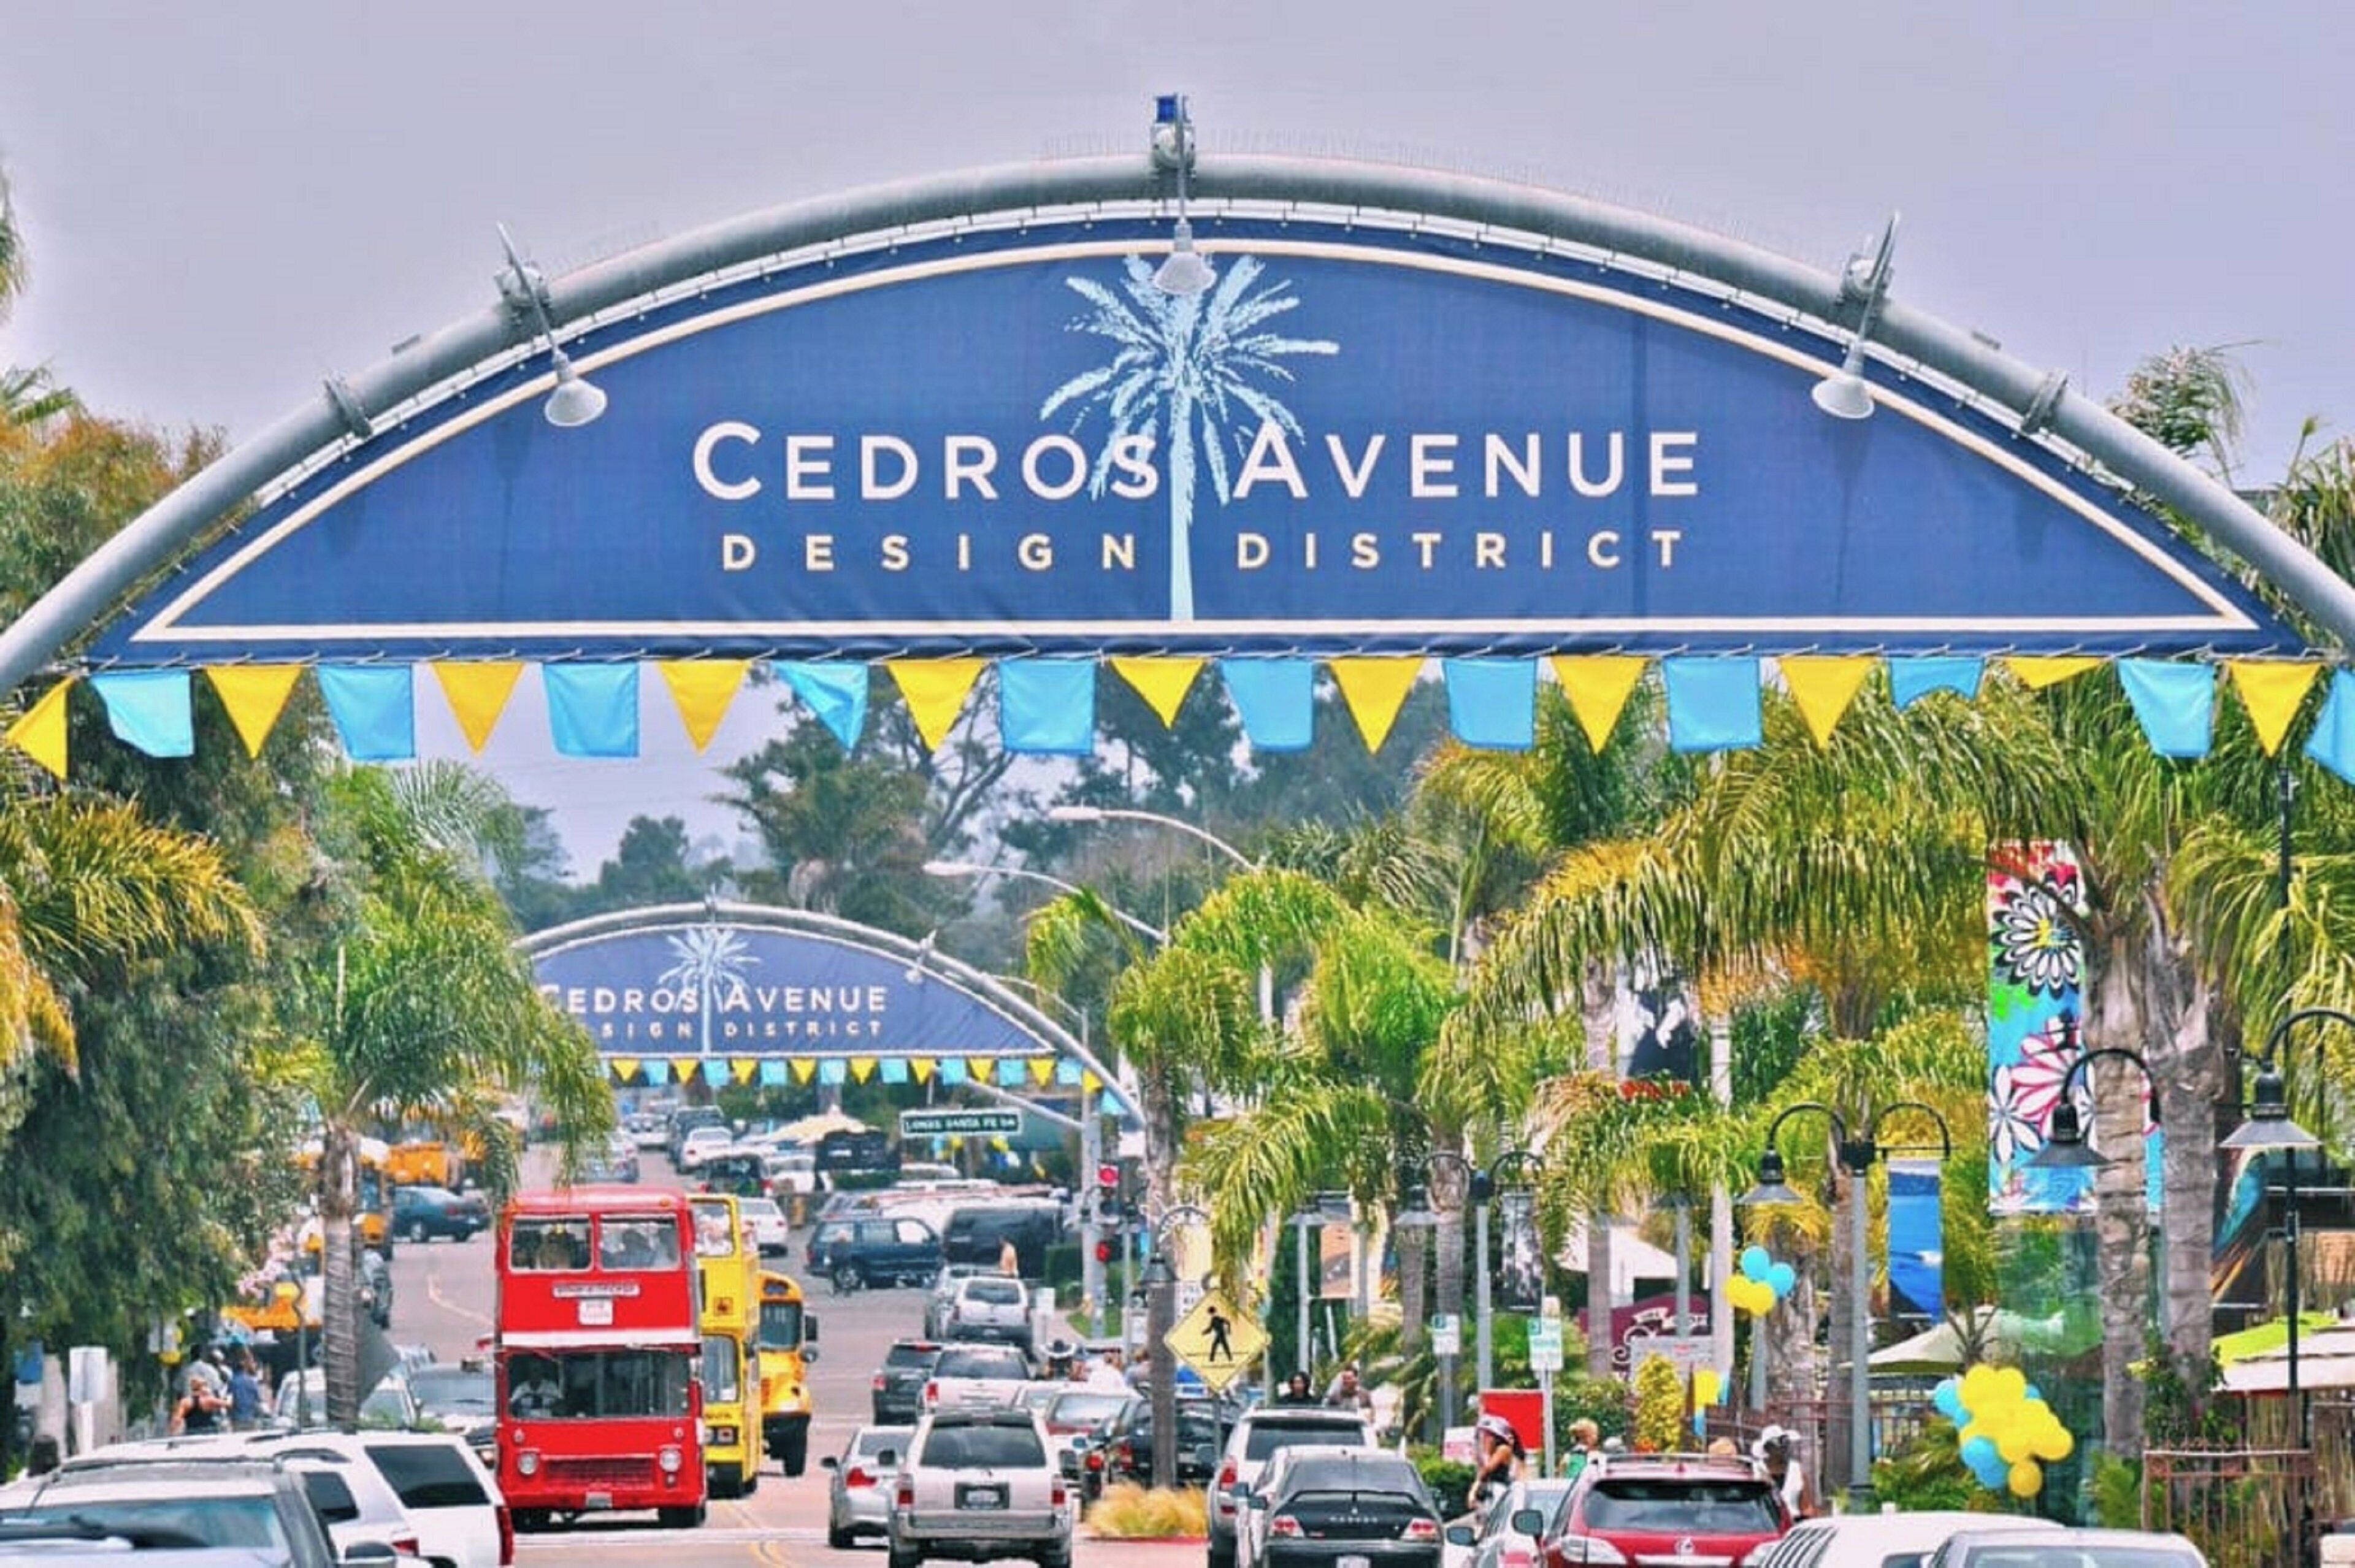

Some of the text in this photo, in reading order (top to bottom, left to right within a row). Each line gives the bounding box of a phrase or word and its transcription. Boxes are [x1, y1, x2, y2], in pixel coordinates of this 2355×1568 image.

[693, 420, 1698, 500] CEDROS AVENUE
[722, 531, 1681, 570] DESIGN DISTRICT
[723, 985, 887, 1012] AVENUE
[602, 1021, 881, 1038] SIGN DISTRICT
